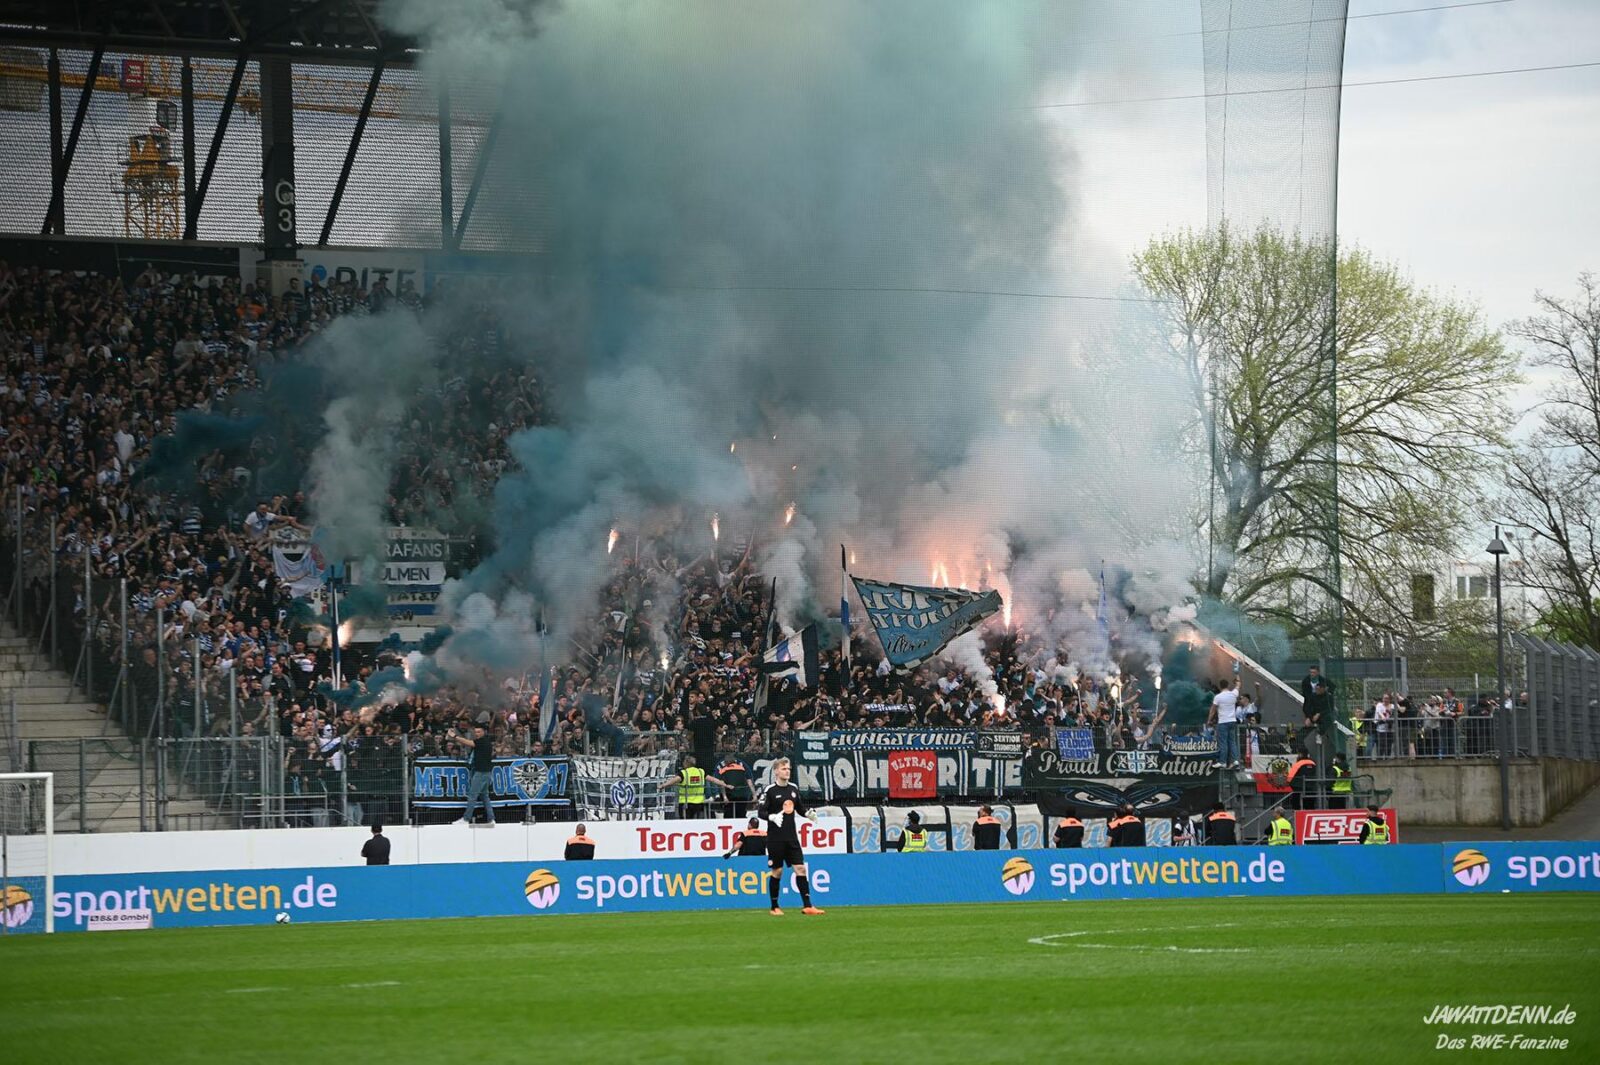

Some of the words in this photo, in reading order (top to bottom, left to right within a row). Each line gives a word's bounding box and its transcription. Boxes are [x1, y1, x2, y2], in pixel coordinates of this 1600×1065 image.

[278, 208, 293, 232] 3
[1163, 735, 1219, 752] Freundeskrei
[575, 758, 671, 778] RUHRPOTT
[797, 757, 1023, 792] KOHRTE
[891, 756, 935, 772] ULTRAS
[901, 772, 923, 789] MZ
[1050, 852, 1286, 893] sportwetten.de
[54, 876, 338, 924] sportwetten.de
